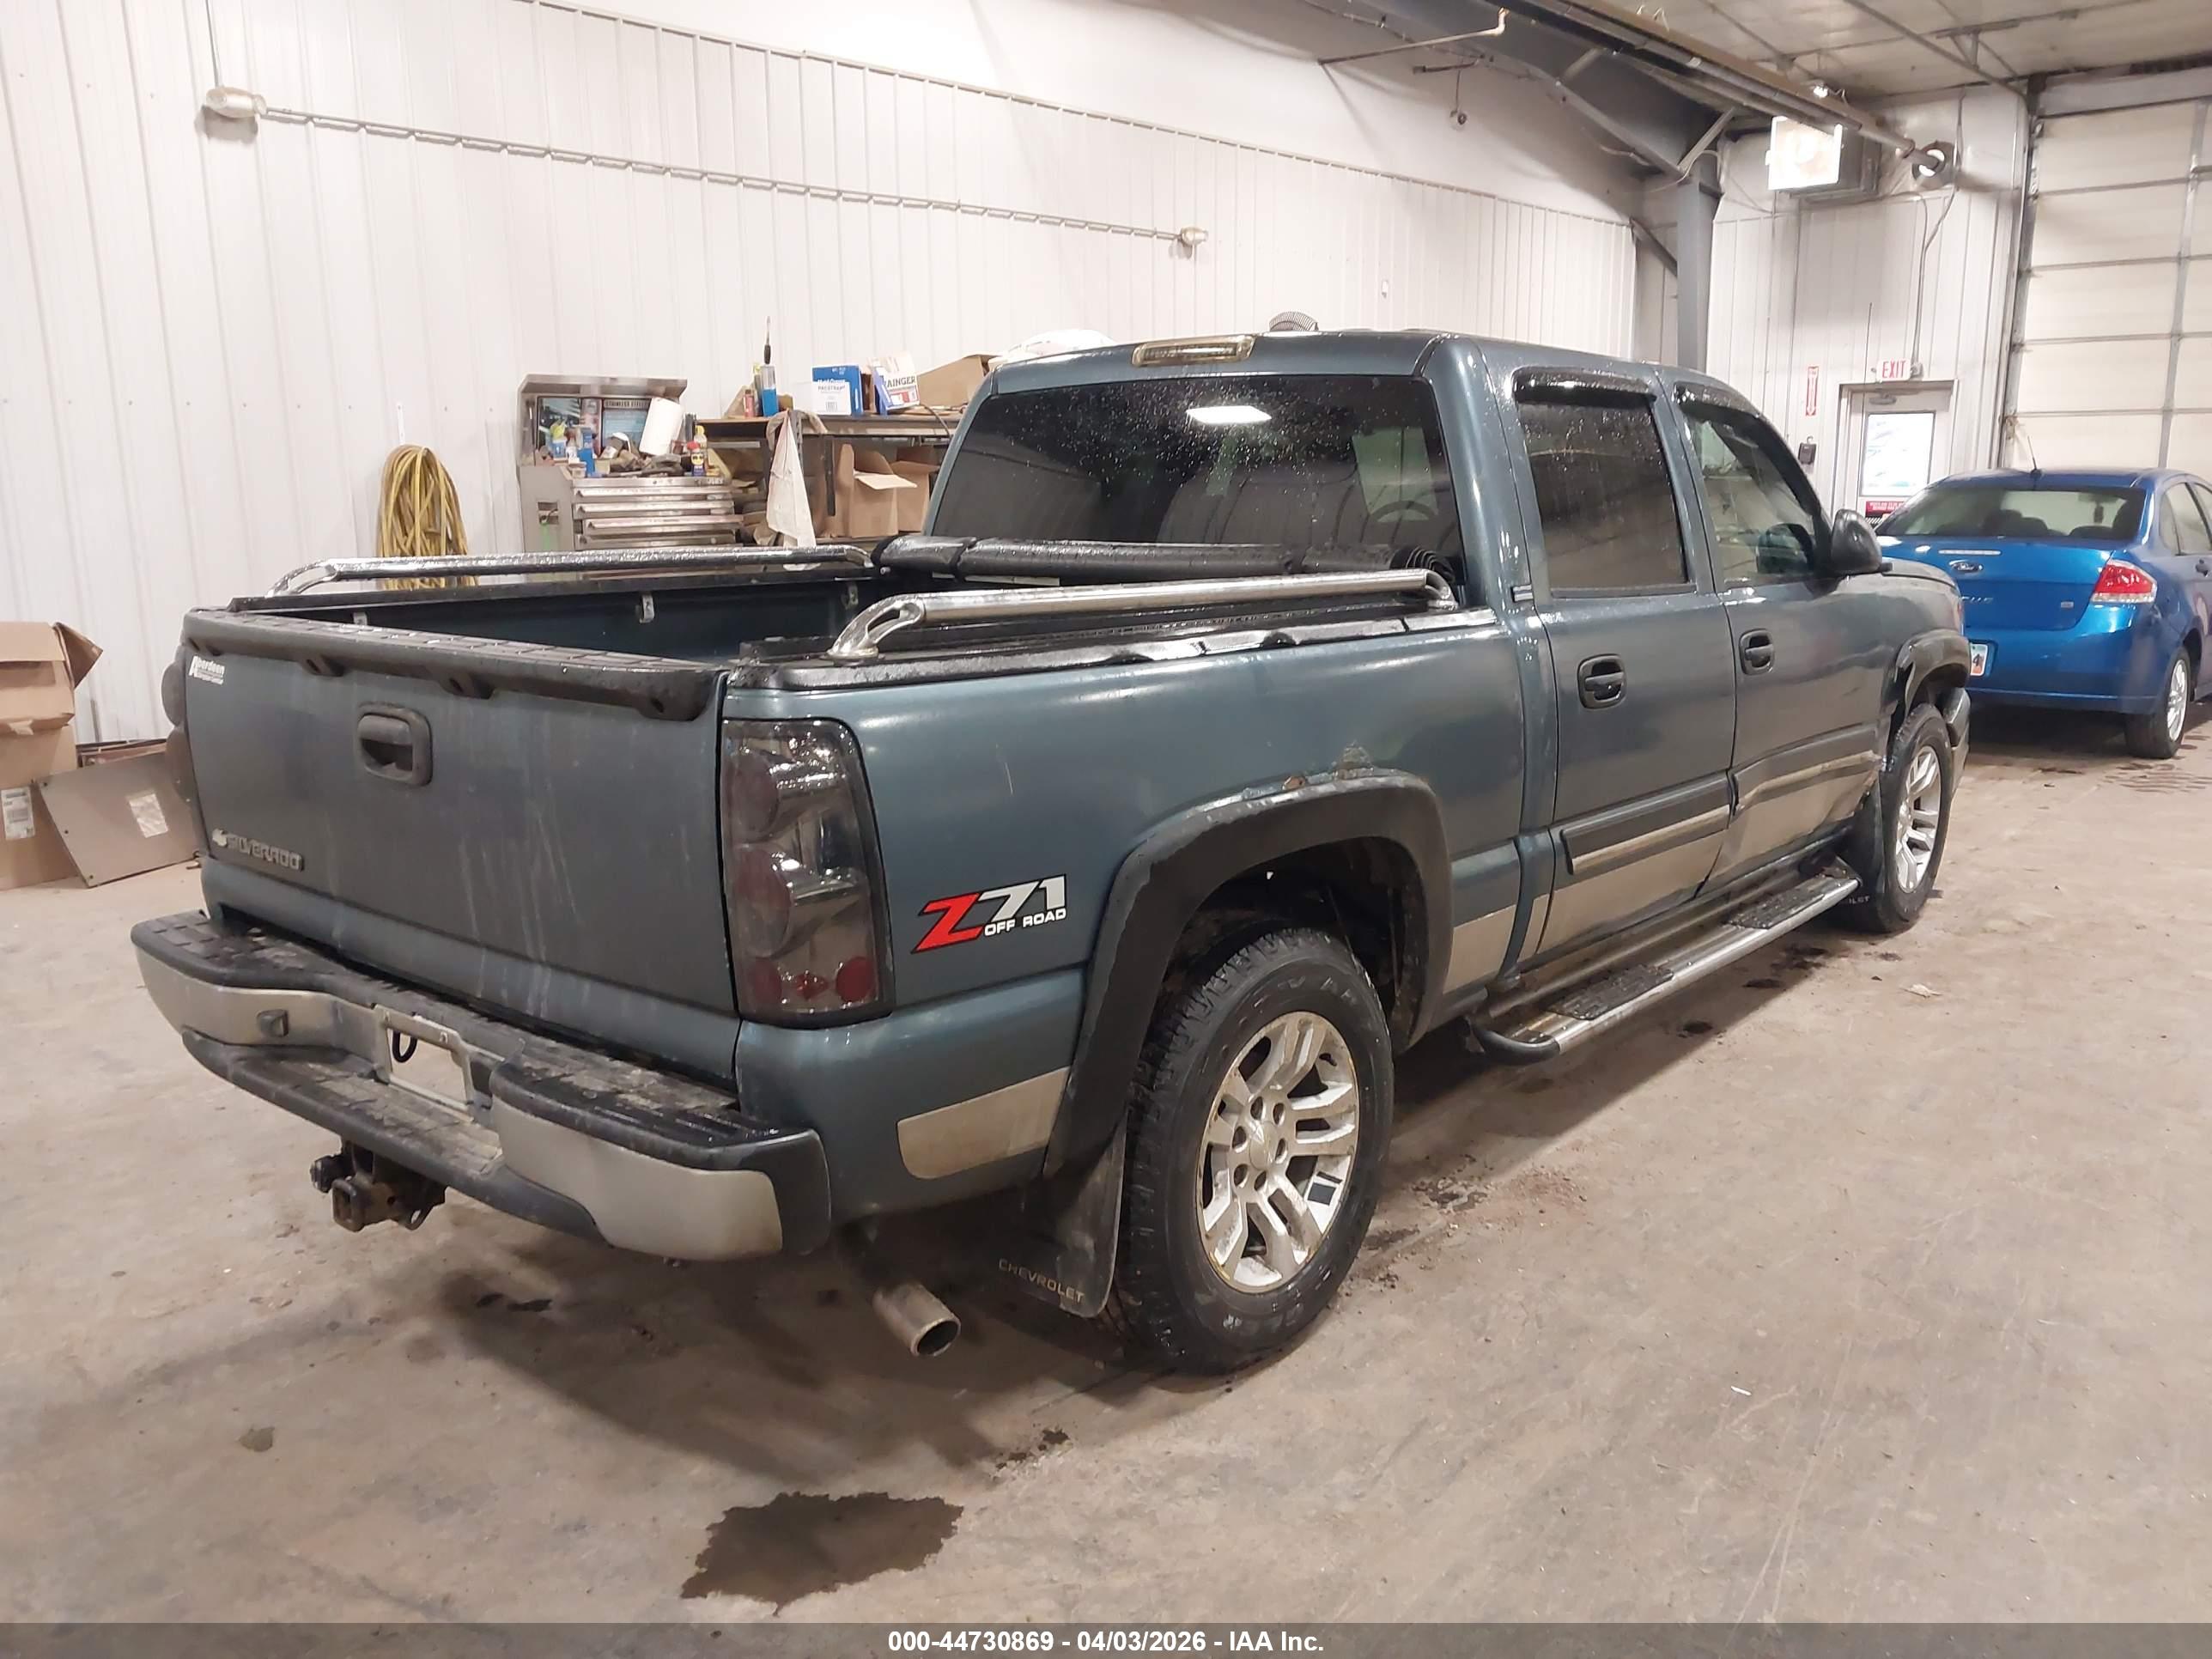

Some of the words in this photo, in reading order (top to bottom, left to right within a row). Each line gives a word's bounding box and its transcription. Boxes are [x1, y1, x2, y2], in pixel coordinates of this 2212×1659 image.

[1882, 360, 1906, 379] EXIT
[910, 873, 1067, 954] Z71
[984, 919, 1016, 937] OFF
[1022, 908, 1067, 928] ROAD
[998, 1257, 1086, 1304] CHEVROLET
